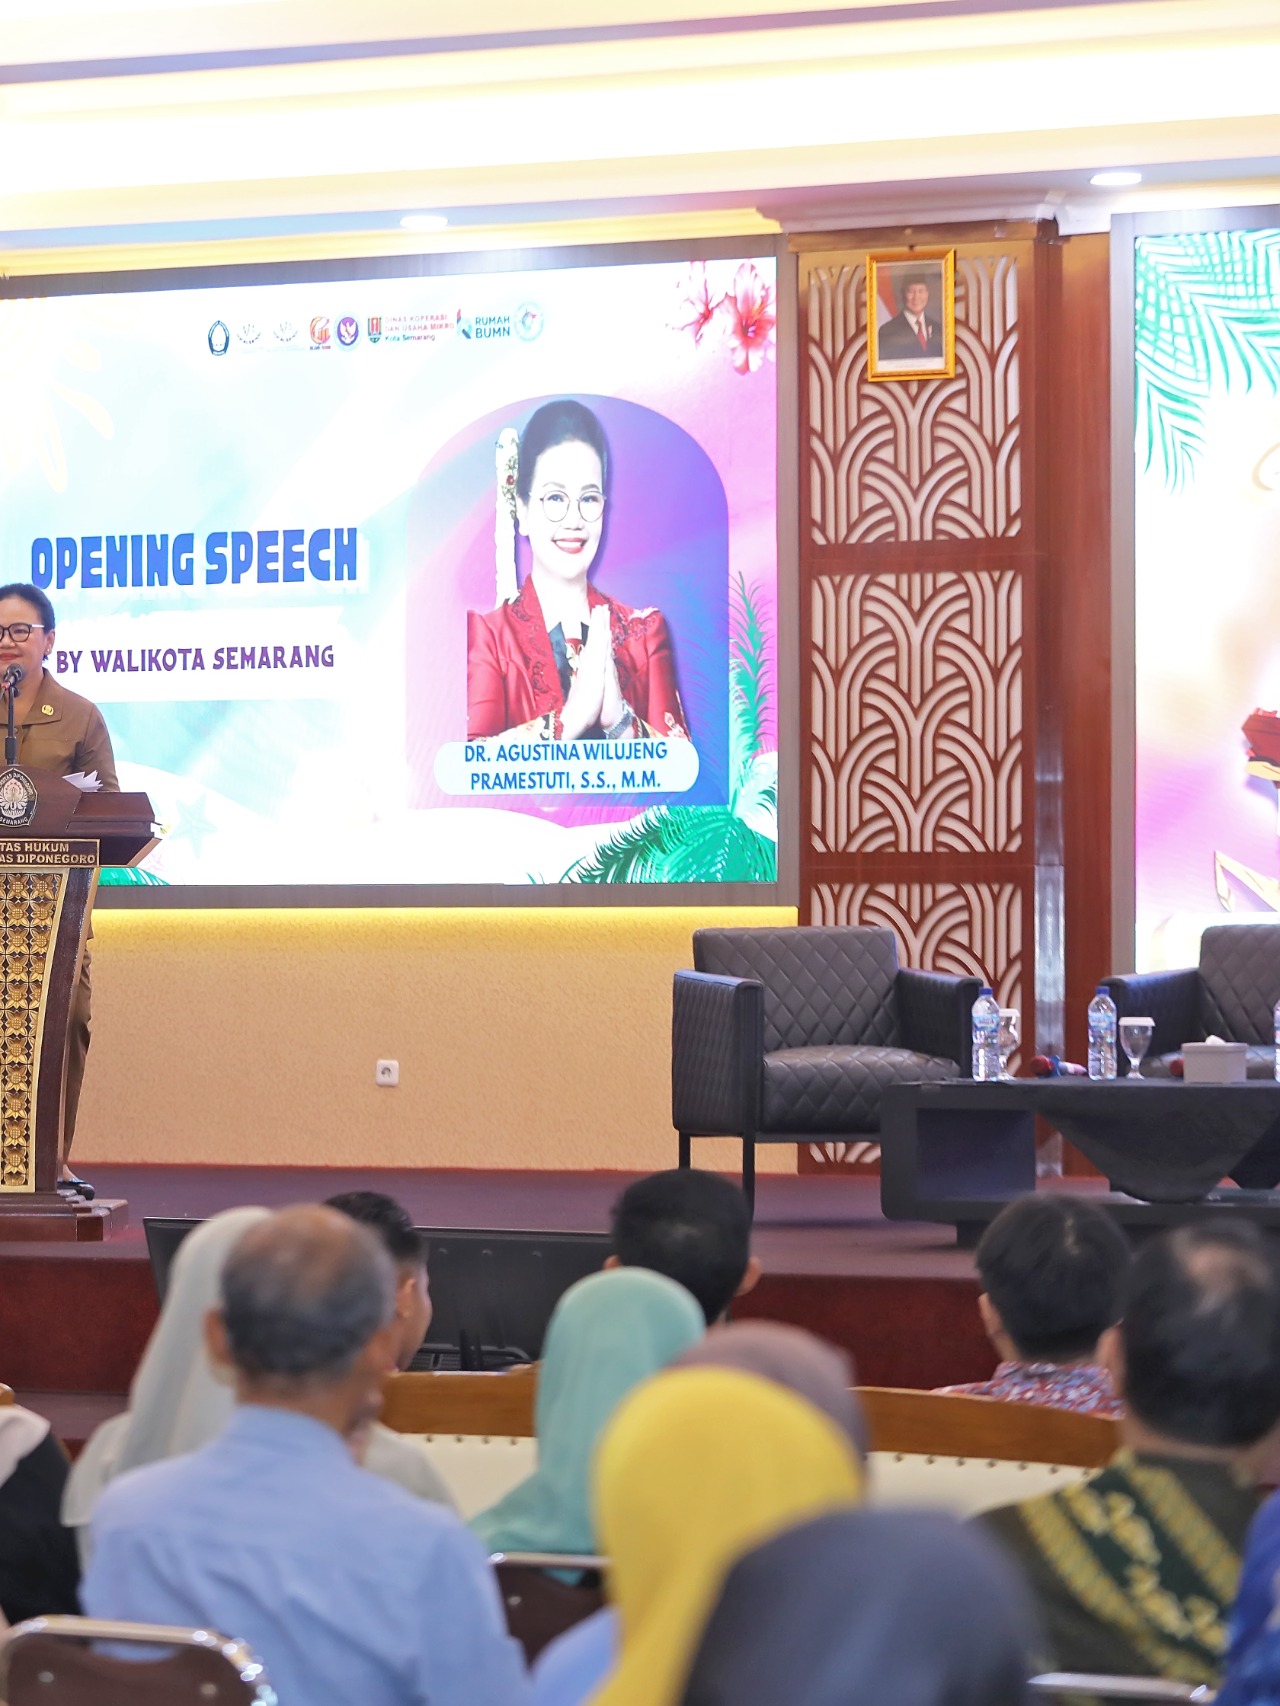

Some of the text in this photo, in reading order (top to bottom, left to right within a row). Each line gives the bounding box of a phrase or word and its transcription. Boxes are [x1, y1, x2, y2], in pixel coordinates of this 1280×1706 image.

[409, 314, 448, 322] KOPERASI
[475, 315, 510, 326] RUMAH
[402, 324, 428, 332] USAHA
[430, 322, 455, 331] MIKRO
[475, 326, 511, 339] BUMN
[402, 334, 436, 342] Semarang
[31, 527, 357, 590] OPENING SPEECH
[56, 644, 335, 673] BY WALIKOTA SEMARANG
[464, 741, 668, 763] DR. AGUSTINA WILUJENG
[470, 770, 661, 791] PRAMESTUTI, S.S., M.M.
[0, 816, 28, 826] SEMARANG
[24, 843, 69, 853] HUKUM
[16, 854, 96, 864] DIPONEGORO
